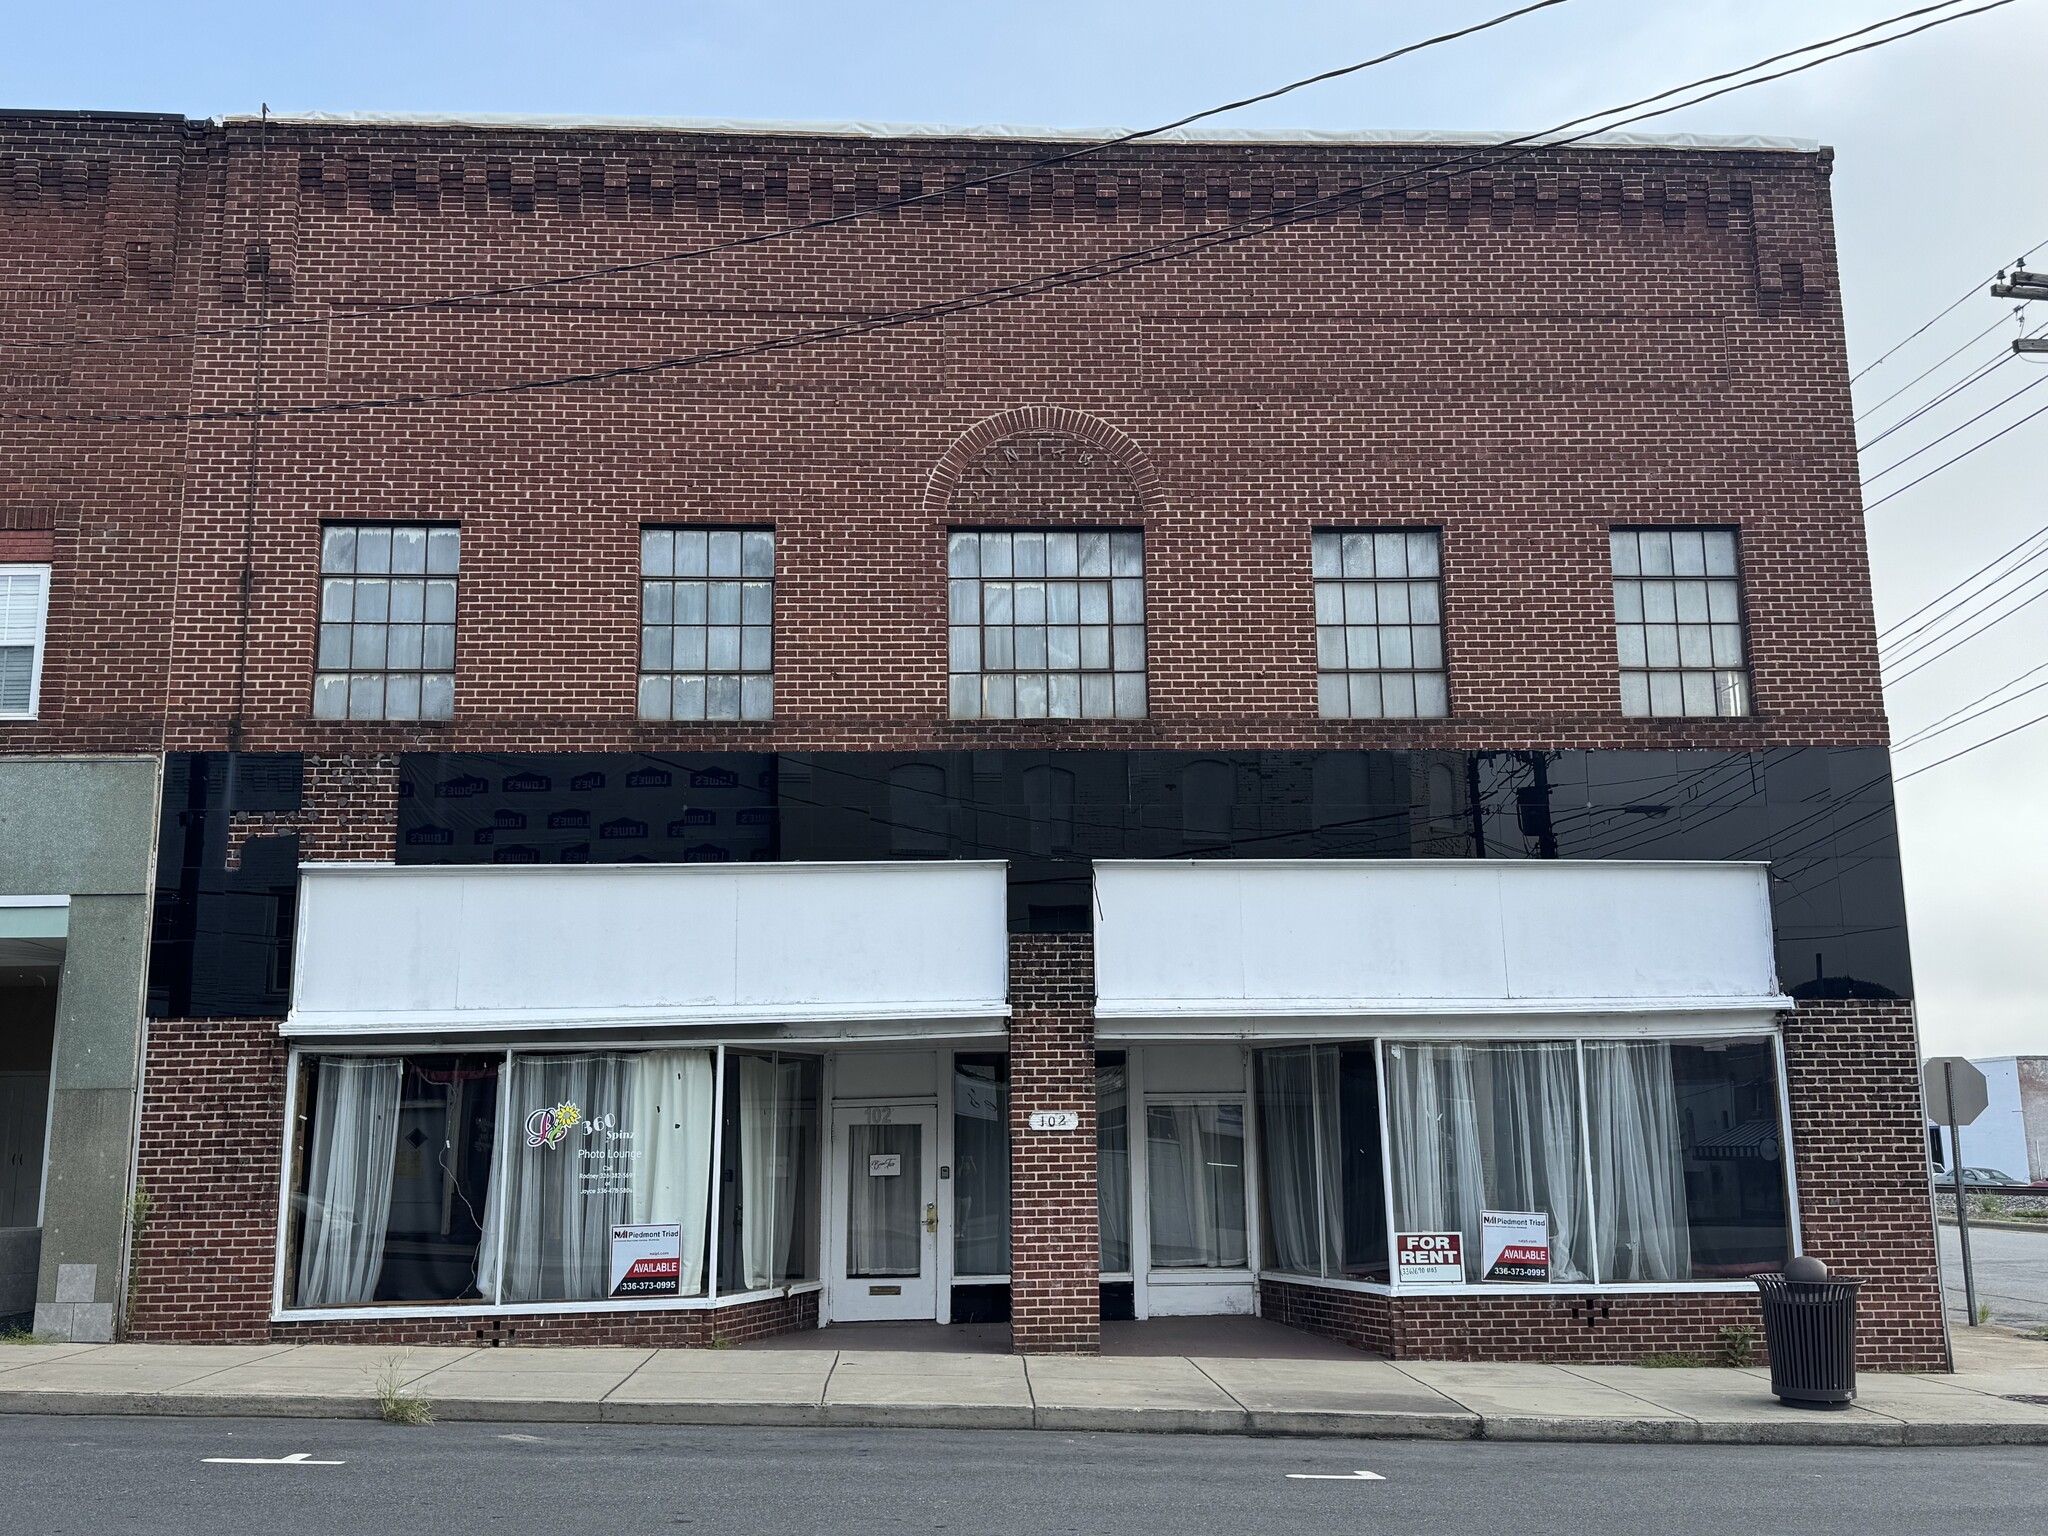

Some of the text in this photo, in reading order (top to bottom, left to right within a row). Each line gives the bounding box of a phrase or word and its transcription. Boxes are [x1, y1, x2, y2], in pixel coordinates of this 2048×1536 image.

[864, 1107, 891, 1123] 102
[582, 1113, 615, 1135] 360
[1041, 1115, 1066, 1127] 102
[607, 1130, 634, 1140] Spinz
[578, 1149, 642, 1160] Photo Lounge
[1497, 1218, 1527, 1226] Piedmont
[1407, 1237, 1449, 1250] FOR
[1401, 1251, 1457, 1263] RENT
[1504, 1249, 1546, 1260] AVAILABLE
[634, 1262, 677, 1273] AVAILABLE
[1494, 1267, 1546, 1276] 336-373-0995
[622, 1281, 676, 1290] 336-373-0995
